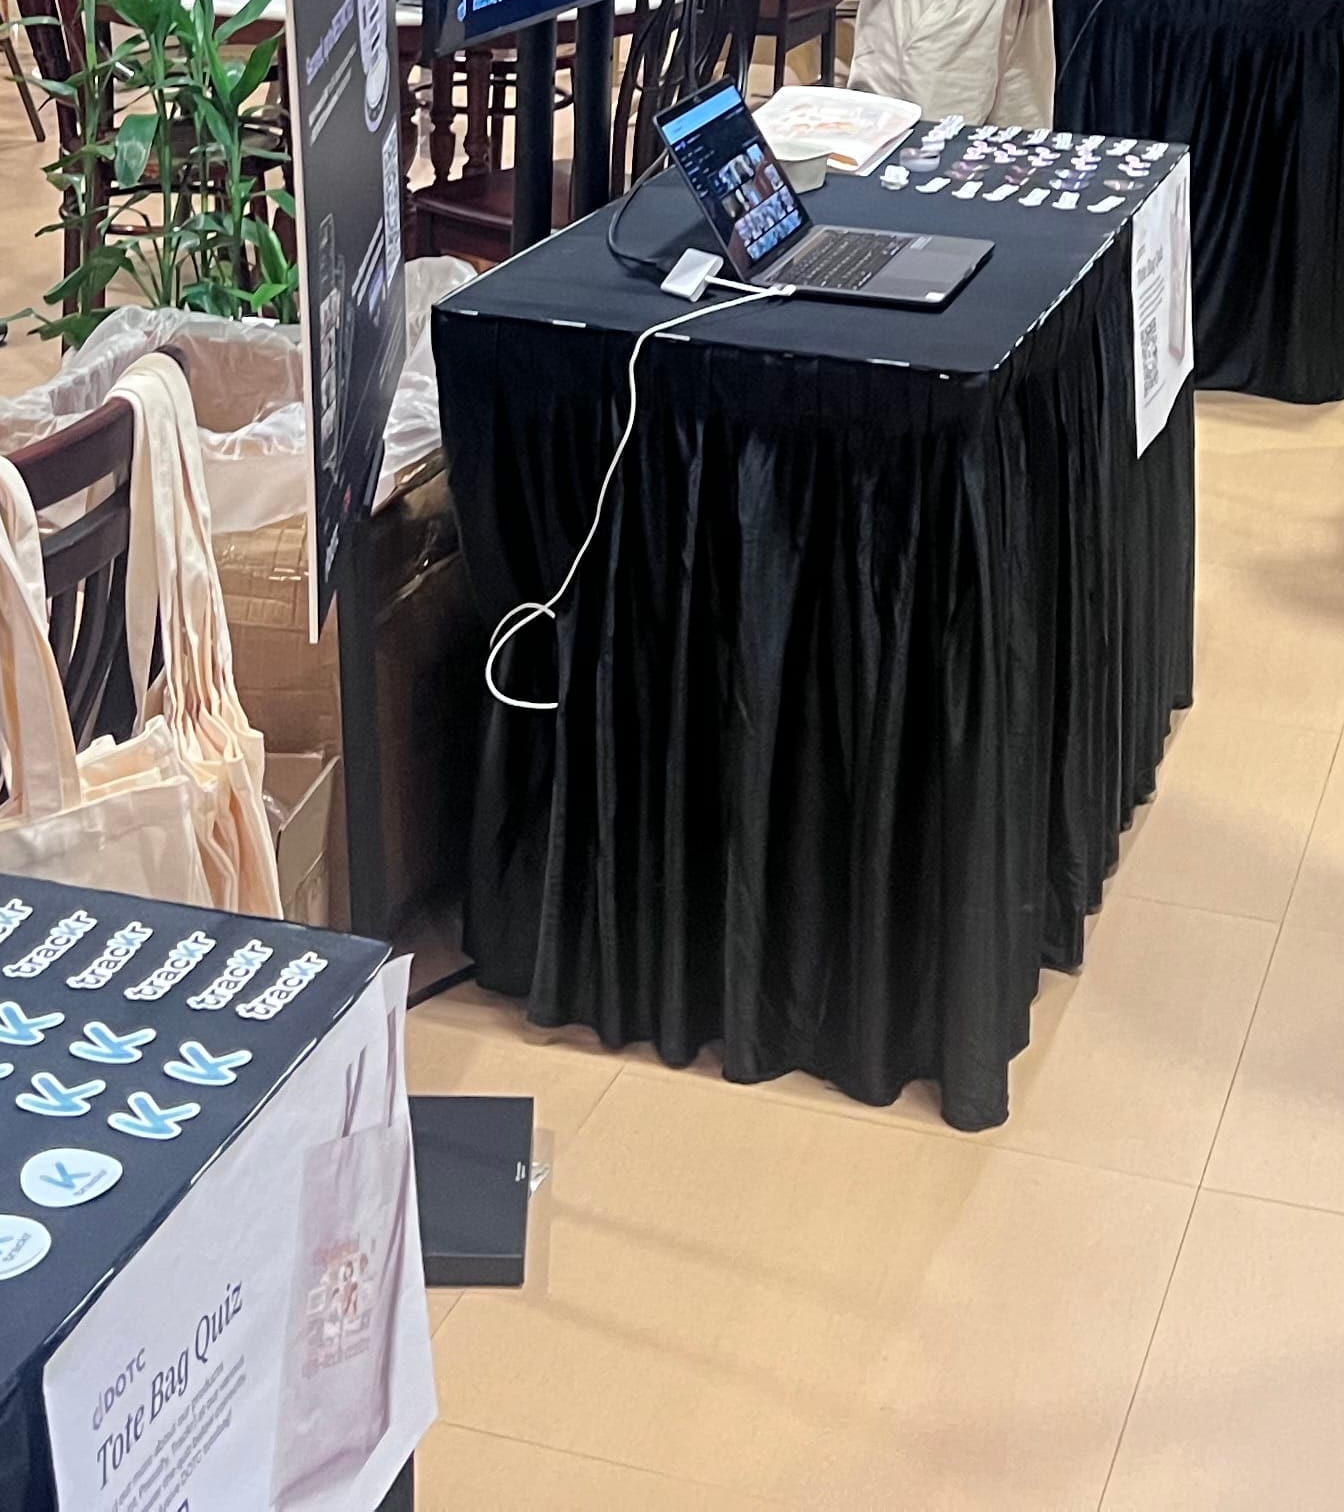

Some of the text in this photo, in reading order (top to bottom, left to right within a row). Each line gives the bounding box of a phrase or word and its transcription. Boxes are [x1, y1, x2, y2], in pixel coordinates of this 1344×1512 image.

[96, 1403, 146, 1491] Tote
[149, 1346, 190, 1426] Bag
[194, 1279, 244, 1364] Quiz
